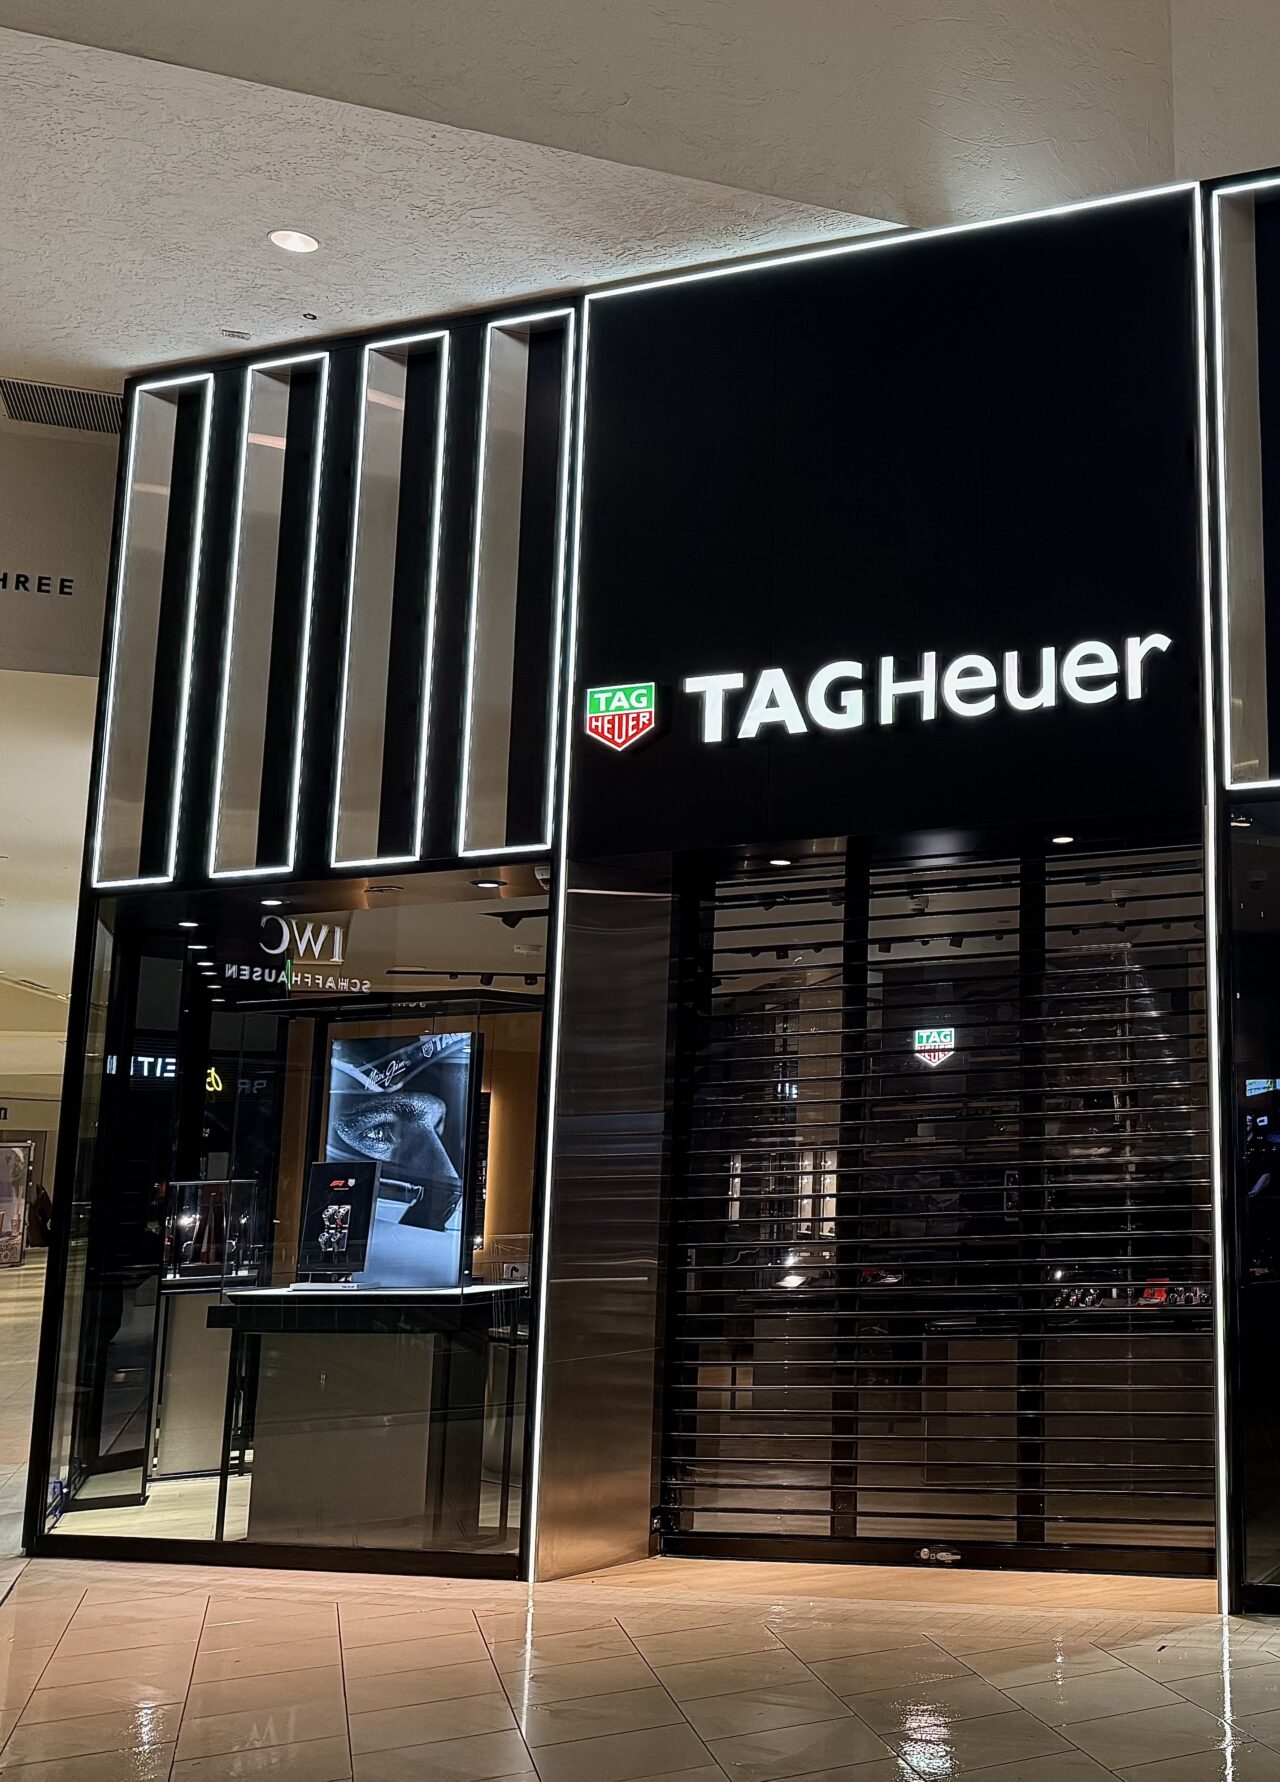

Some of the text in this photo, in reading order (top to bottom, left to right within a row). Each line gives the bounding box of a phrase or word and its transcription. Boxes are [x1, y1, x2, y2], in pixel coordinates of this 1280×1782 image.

[593, 690, 649, 711] TAG
[589, 711, 651, 743] HEUER
[919, 1031, 951, 1043] TAG
